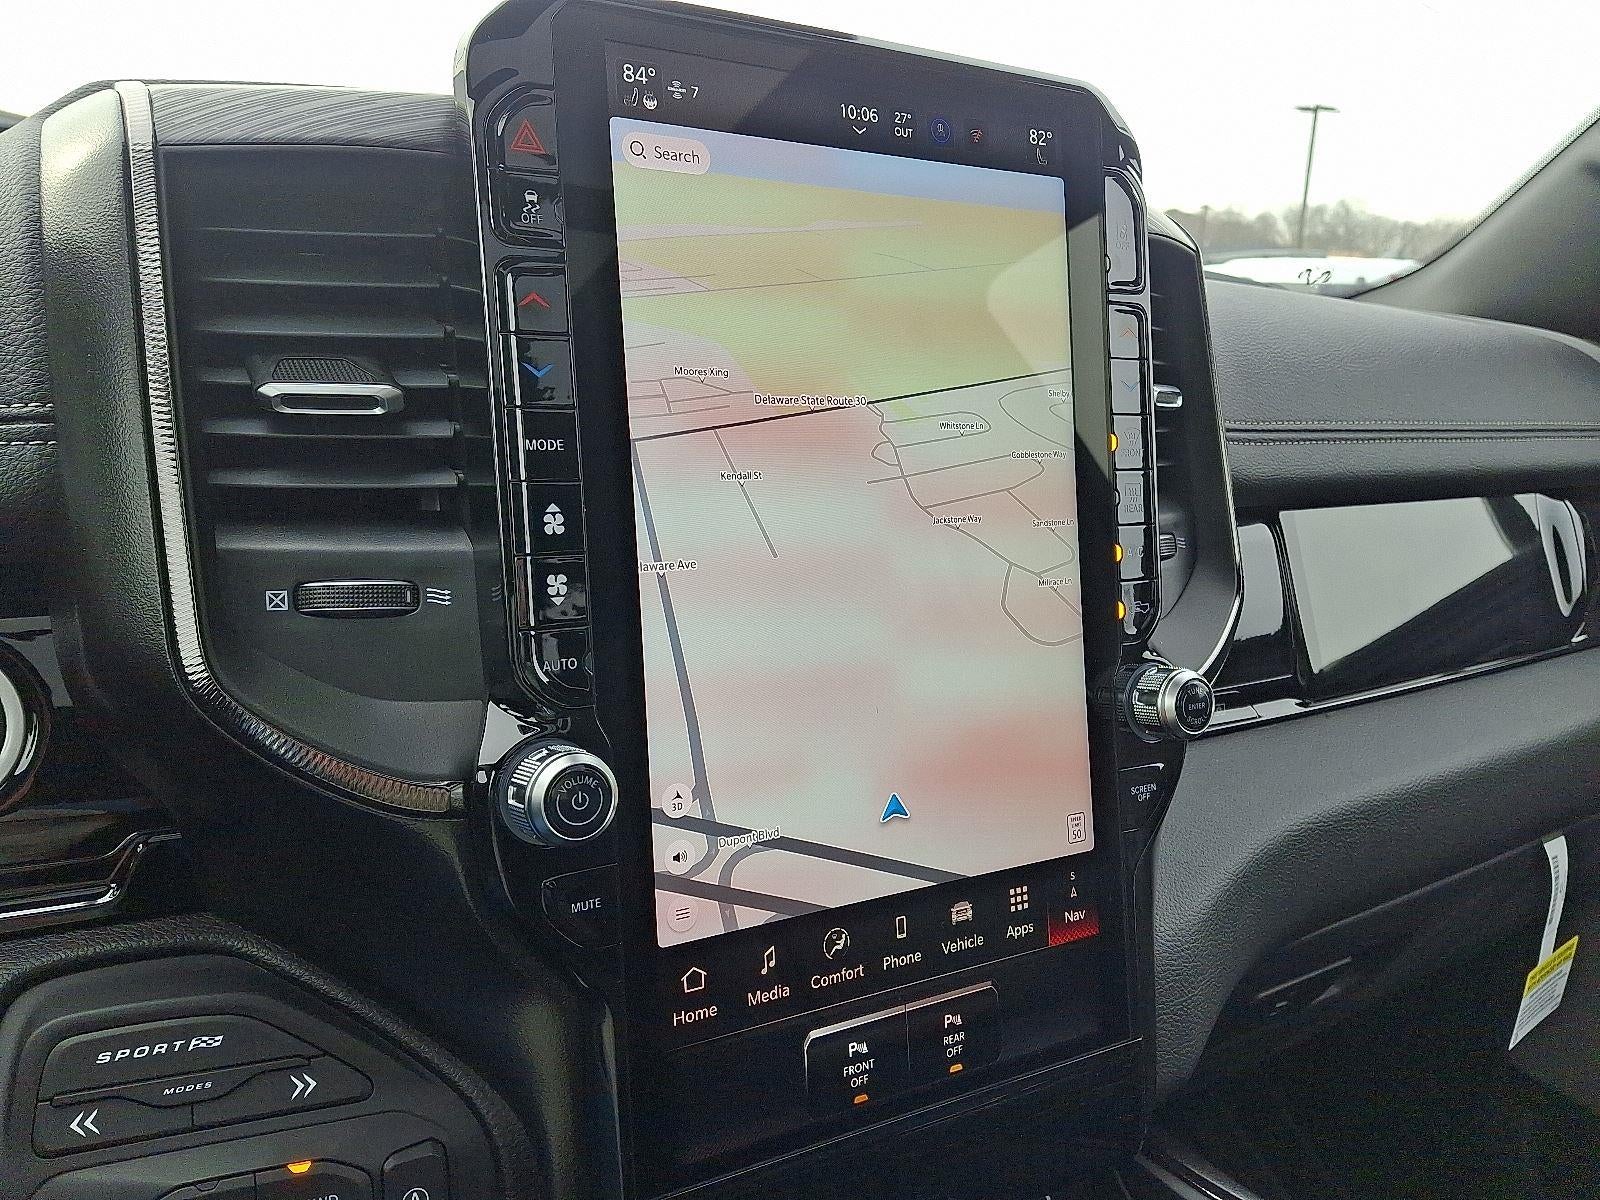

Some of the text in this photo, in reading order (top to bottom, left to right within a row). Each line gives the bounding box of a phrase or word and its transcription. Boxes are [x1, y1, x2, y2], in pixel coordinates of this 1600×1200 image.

[623, 63, 657, 85] 84°
[691, 86, 699, 99] 7
[840, 104, 879, 124] 10:06
[894, 112, 912, 125] 27°
[894, 127, 913, 139] OUT
[1029, 129, 1053, 147] 82°
[654, 146, 700, 166] Search
[521, 212, 544, 224] OFF
[674, 366, 729, 378] Moores Xing
[754, 394, 867, 407] Delaware State Route 30
[939, 422, 984, 431] Whitstone Ln
[525, 439, 565, 451] MODE
[1052, 451, 1067, 459] Way
[720, 471, 762, 481] Kendall St
[933, 515, 982, 525] Jackstone Way
[1032, 518, 1075, 528] Sandstone Ln
[638, 560, 697, 573] laware Ave
[1063, 578, 1073, 586] Ln
[543, 658, 578, 672] AUTO
[1188, 702, 1206, 711] ENTER
[558, 774, 600, 795] VOLUME
[1131, 783, 1157, 796] SCREEN
[1138, 793, 1150, 802] OFF
[671, 801, 684, 812] 3D
[718, 828, 780, 848] Dupont Blvd
[1072, 829, 1082, 840] 50
[1070, 871, 1076, 880] S
[571, 898, 602, 913] MUTE
[1064, 908, 1087, 923] Nav
[1006, 922, 1035, 939] Apps
[941, 935, 984, 954] Vehicle
[883, 951, 923, 971] Phone
[811, 965, 865, 990] Comfort
[747, 984, 791, 1006] Media
[672, 1005, 718, 1027] Home
[943, 1032, 965, 1045] REAR
[96, 1040, 186, 1064] SPORT
[946, 1045, 964, 1058] OFF
[843, 1059, 875, 1077] FRONT
[850, 1074, 869, 1088] OFF
[163, 1081, 213, 1096] MODES
